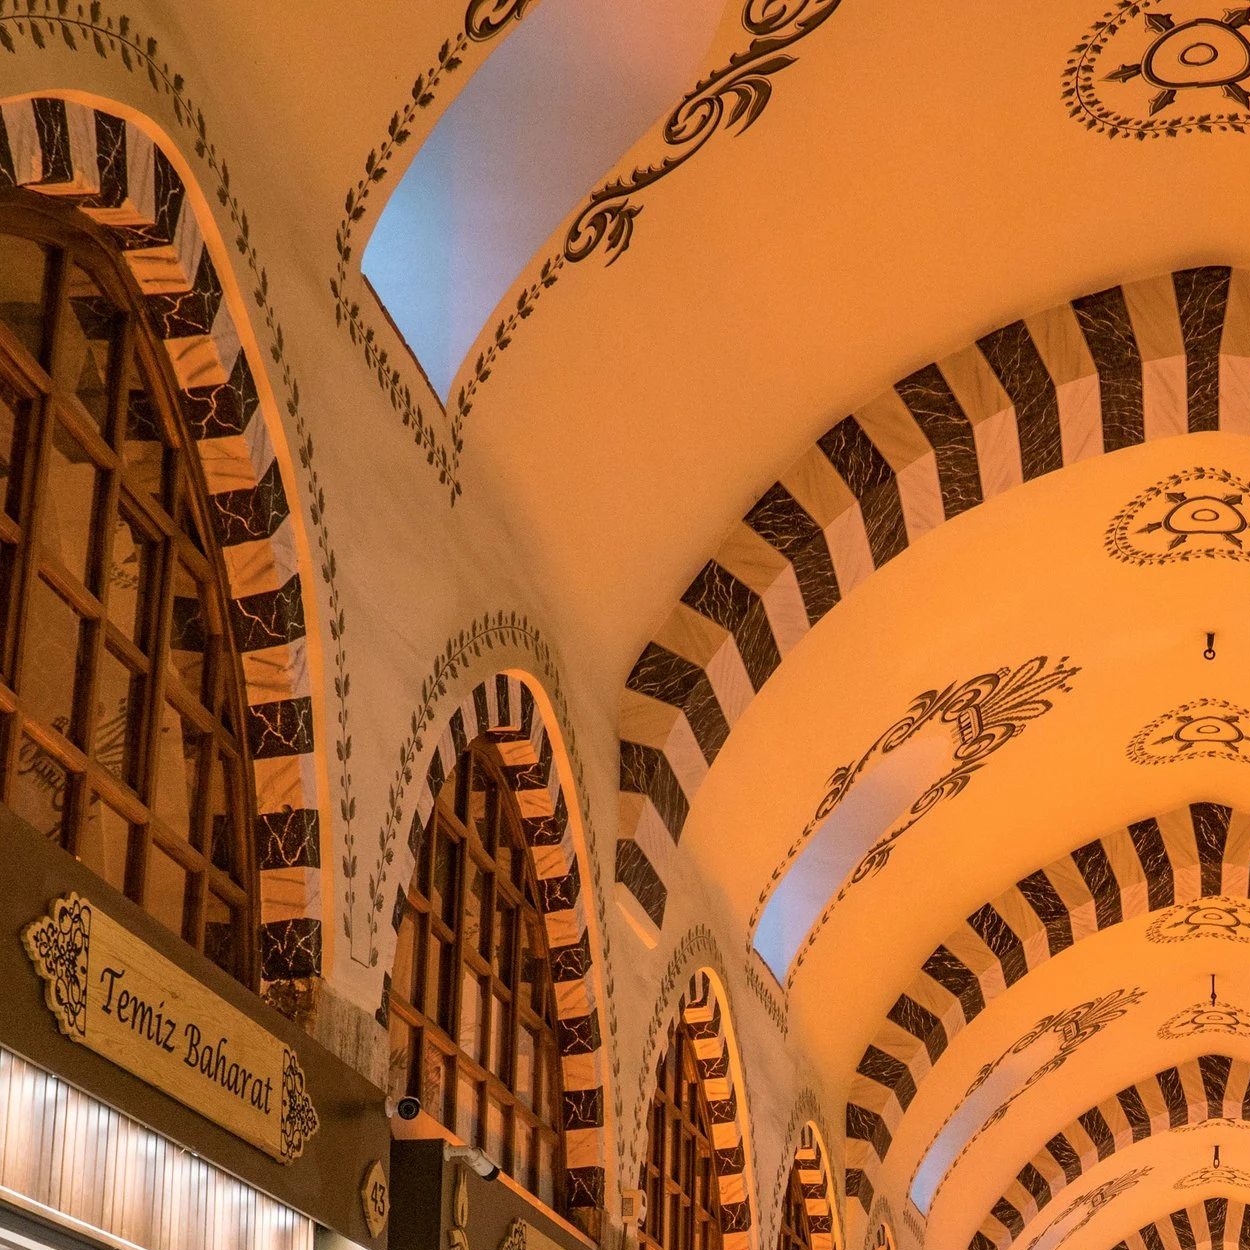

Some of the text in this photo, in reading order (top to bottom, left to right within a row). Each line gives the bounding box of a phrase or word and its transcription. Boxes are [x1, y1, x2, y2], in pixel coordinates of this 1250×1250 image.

[100, 966, 274, 1115] Temiz Baharat
[370, 1180, 386, 1217] 43
